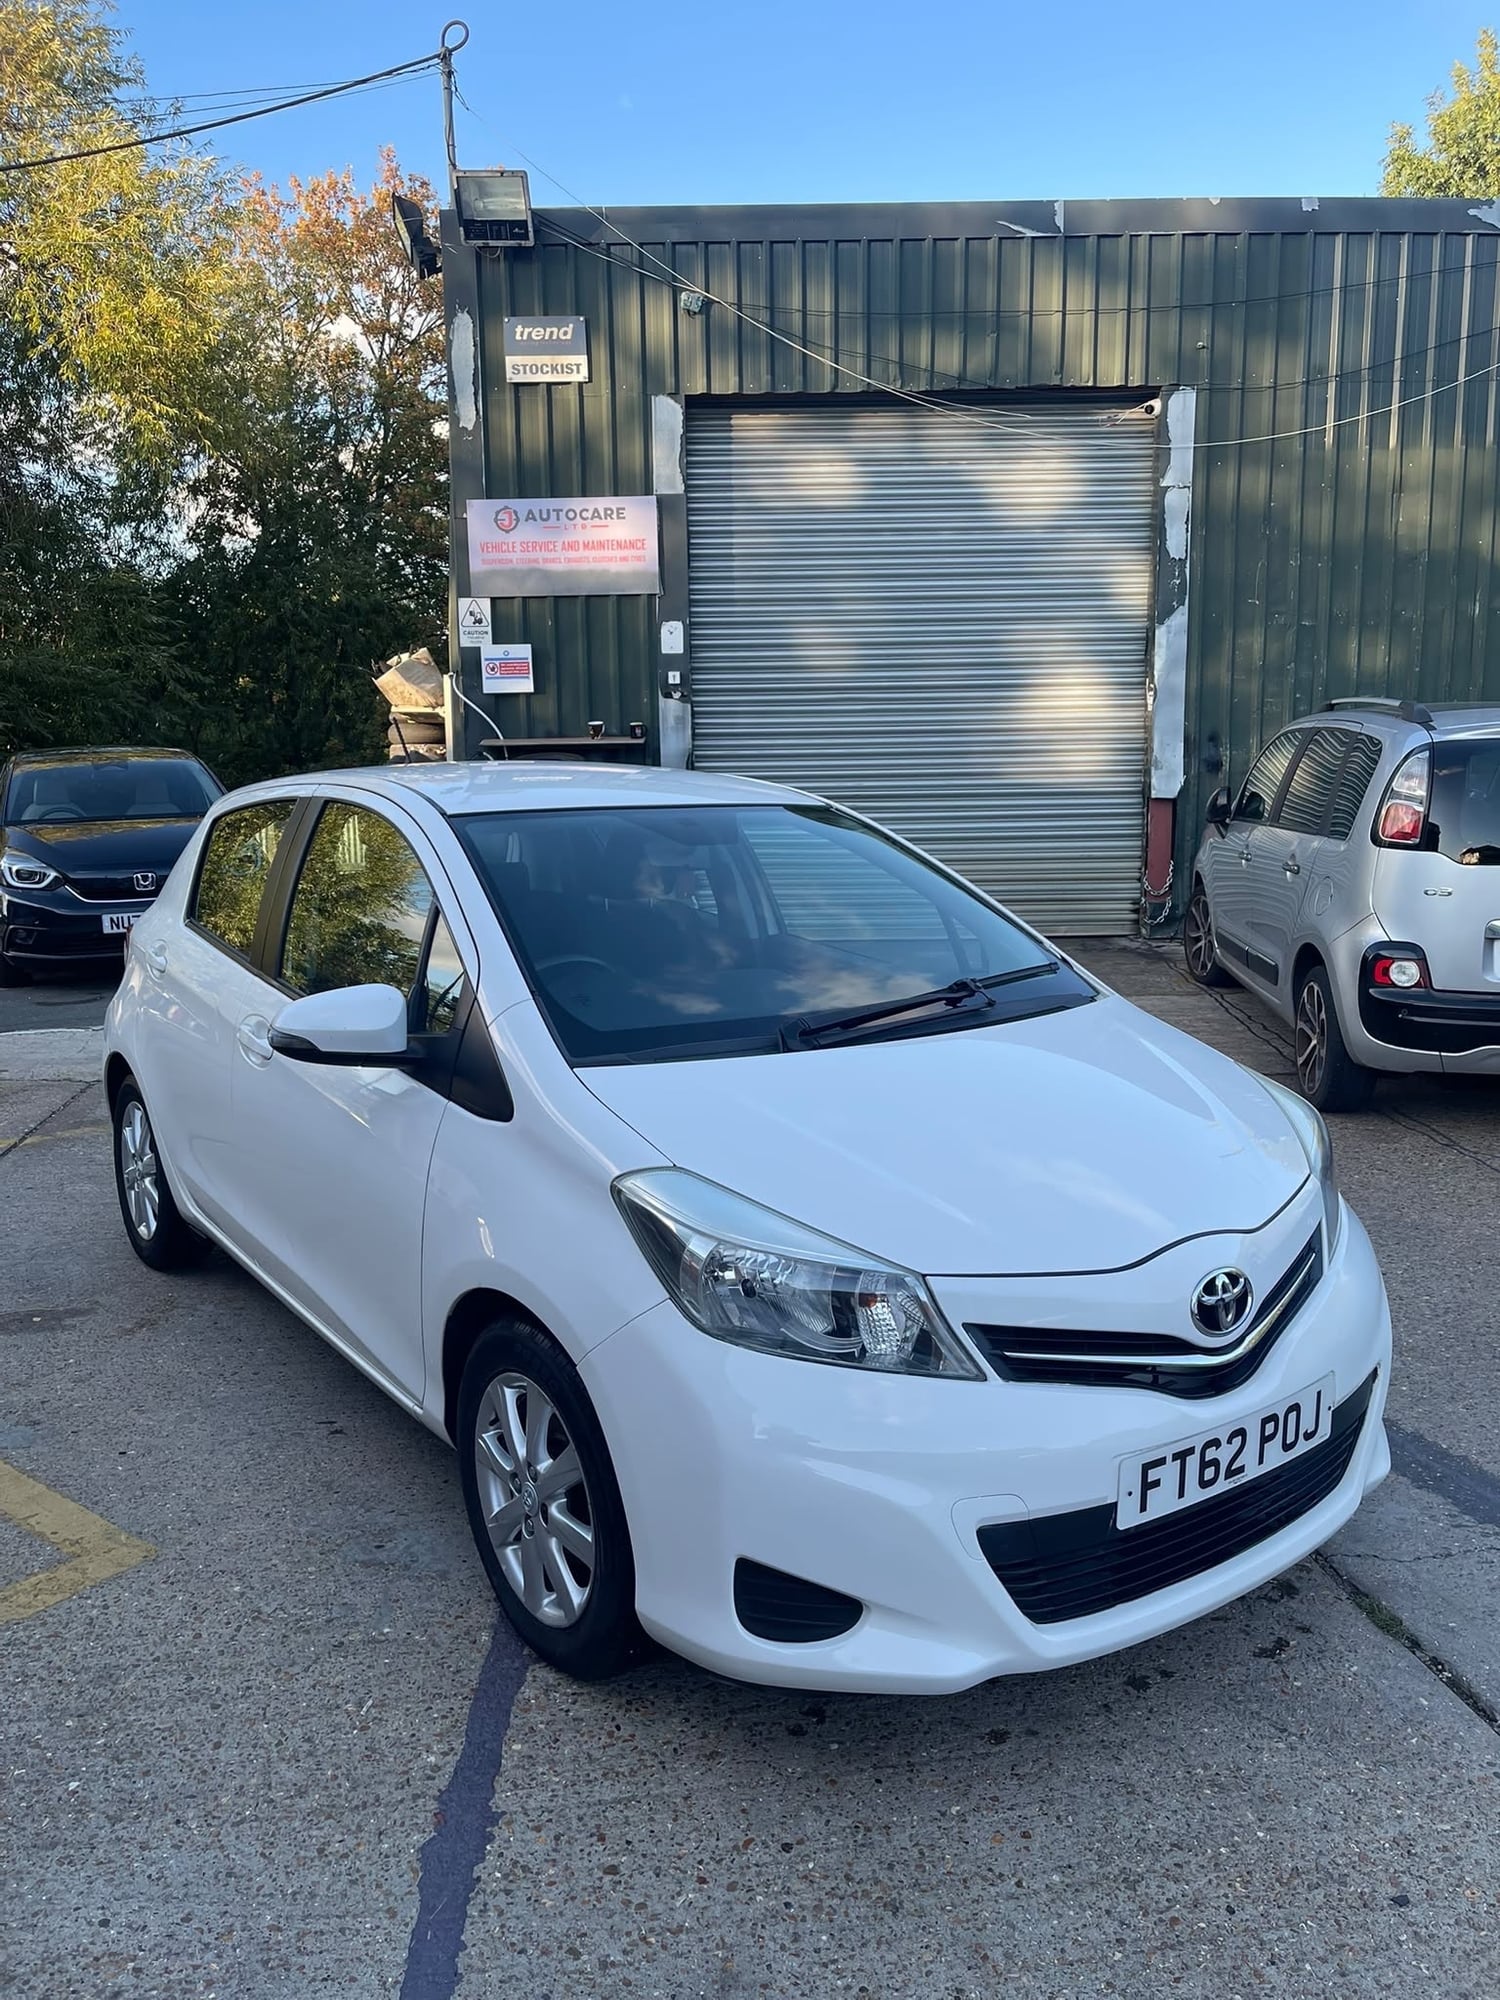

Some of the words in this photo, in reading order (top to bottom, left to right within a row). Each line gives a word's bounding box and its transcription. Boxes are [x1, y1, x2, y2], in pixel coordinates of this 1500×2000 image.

[514, 323, 574, 340] trend
[511, 362, 583, 376] STOCKIST
[524, 506, 627, 522] AUTOCARE
[564, 523, 588, 531] LTD
[479, 541, 518, 554] VEHICLE
[519, 540, 559, 553] SERVICE
[560, 539, 580, 553] AND
[582, 538, 648, 552] MAINTENANCE
[1139, 1426, 1248, 1514] FT62
[1257, 1389, 1322, 1467] POJ
